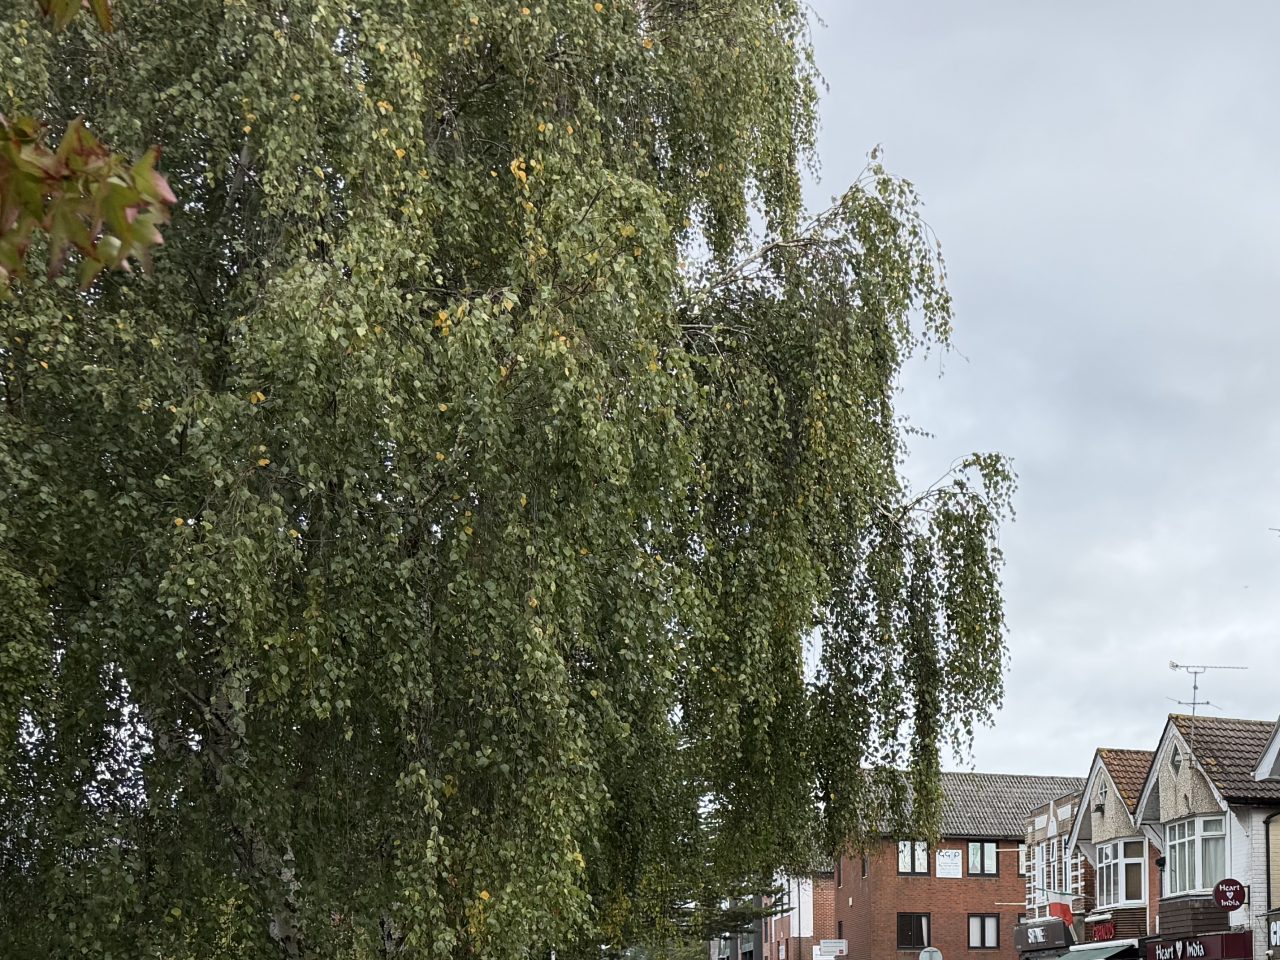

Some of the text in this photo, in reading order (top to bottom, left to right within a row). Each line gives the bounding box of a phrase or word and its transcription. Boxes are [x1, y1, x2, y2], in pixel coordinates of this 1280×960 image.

[1221, 899, 1240, 907] India
[1155, 940, 1205, 960] Heart India
